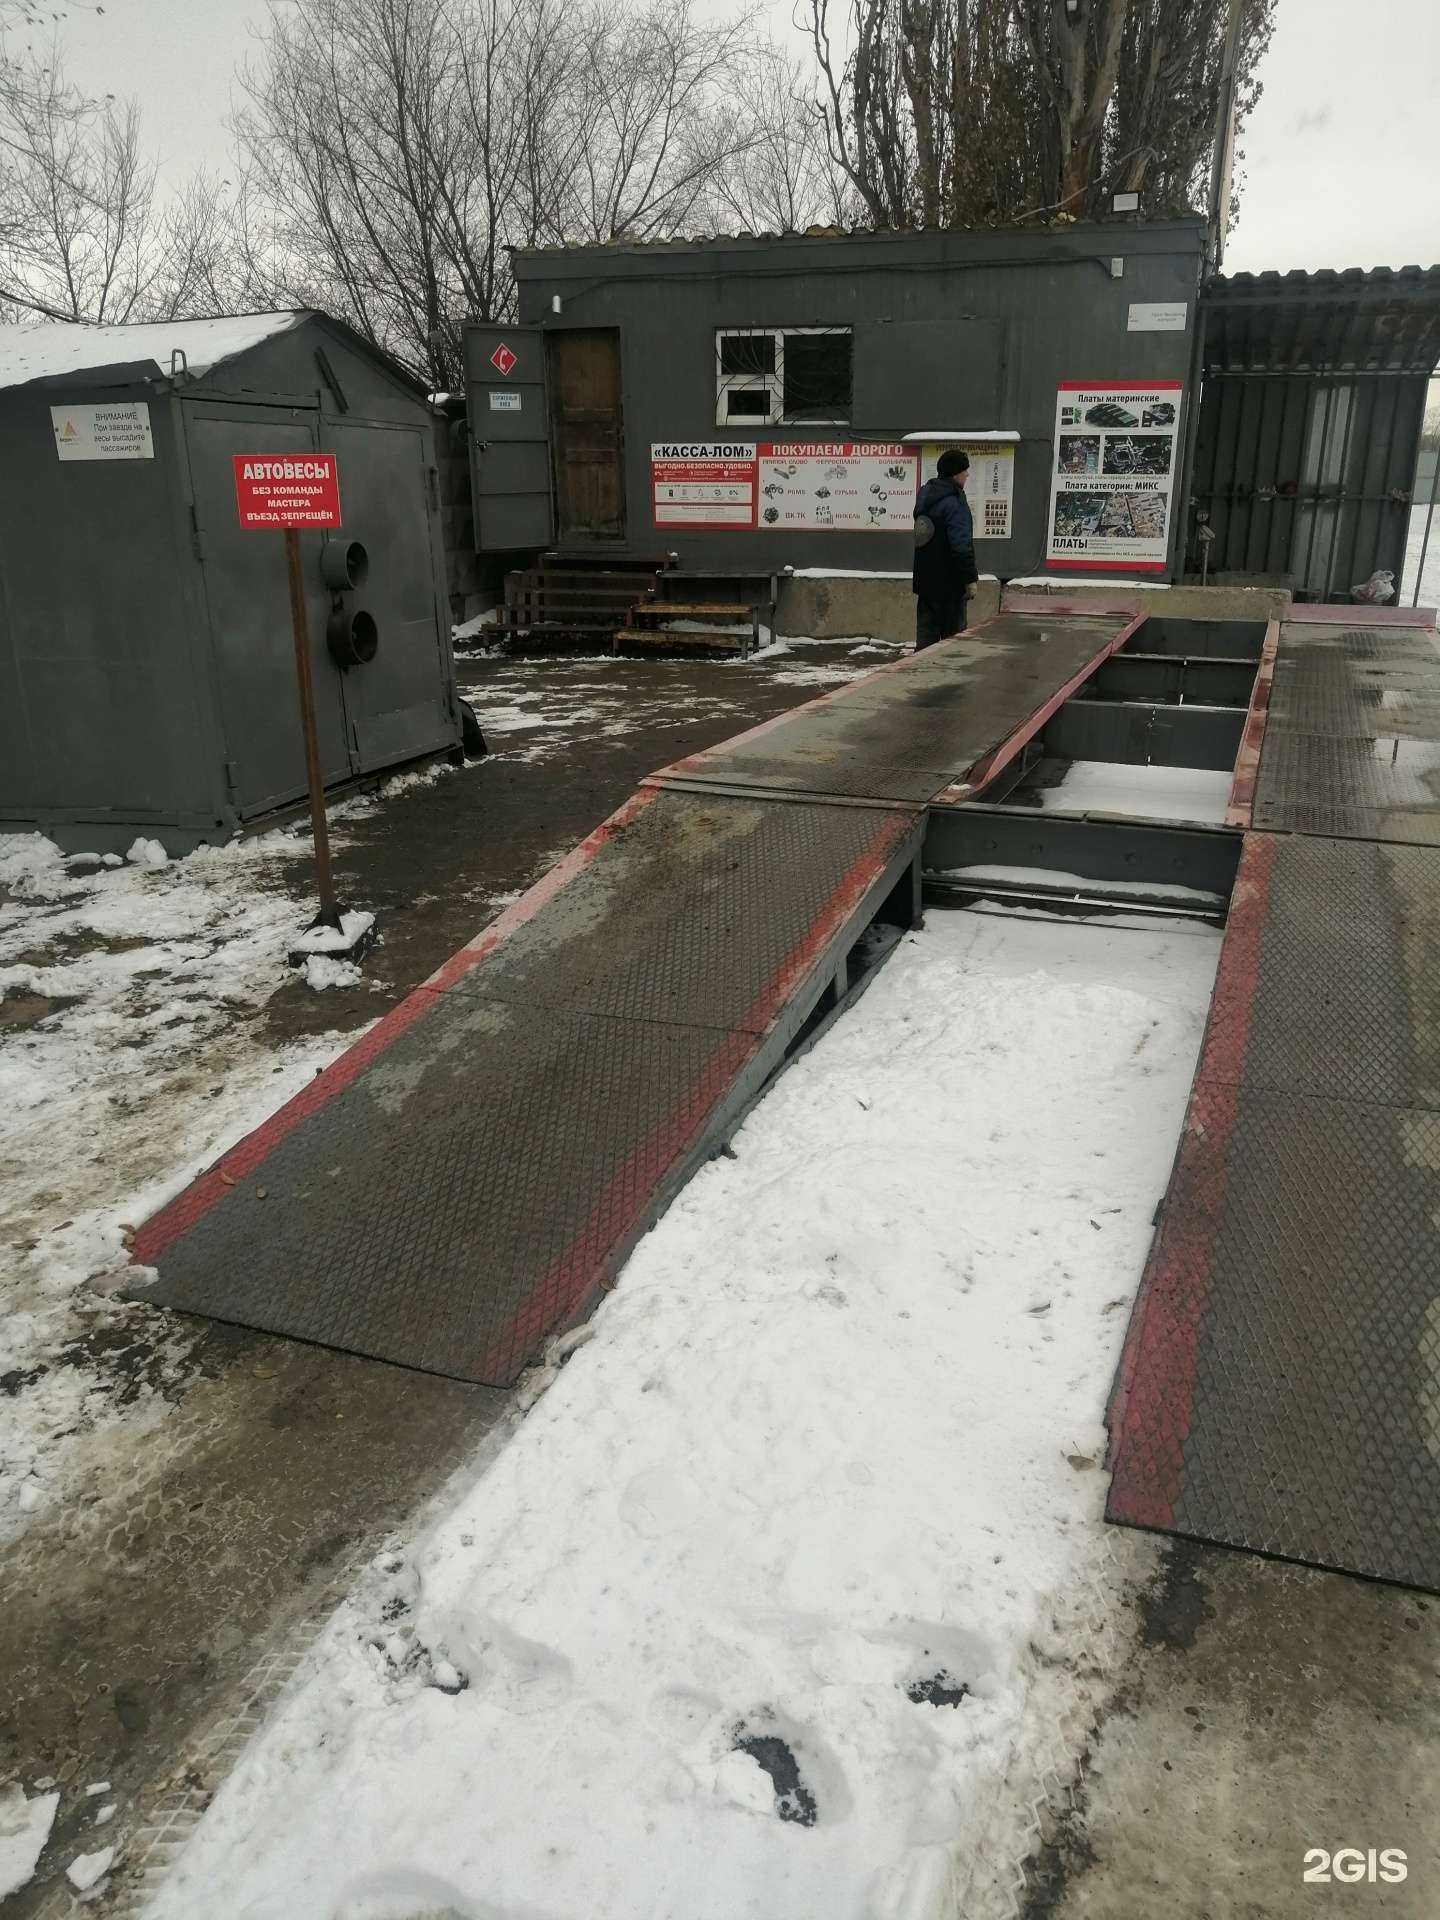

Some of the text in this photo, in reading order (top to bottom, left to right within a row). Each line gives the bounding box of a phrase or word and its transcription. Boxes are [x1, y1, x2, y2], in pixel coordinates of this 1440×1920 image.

[1077, 394, 1160, 404] Платы материнские
[95, 411, 138, 421] ВНИМАНИЕ
[93, 423, 107, 433] При
[133, 423, 143, 431] на
[93, 434, 111, 442] весы
[654, 446, 753, 458] «КАССА-ЛОМ»
[772, 444, 903, 457] ПОКУПАЕМ ДОРОГО
[243, 462, 330, 480] АВТОВЕСЫ
[252, 486, 323, 496] БЕЗ КОМАНДЫ
[1065, 481, 1159, 492] Плата категории: МИКС
[267, 499, 311, 508] МАСТЕРА
[246, 512, 280, 521] ВЪЕЗД
[1052, 539, 1088, 549] ПЛАТЫ
